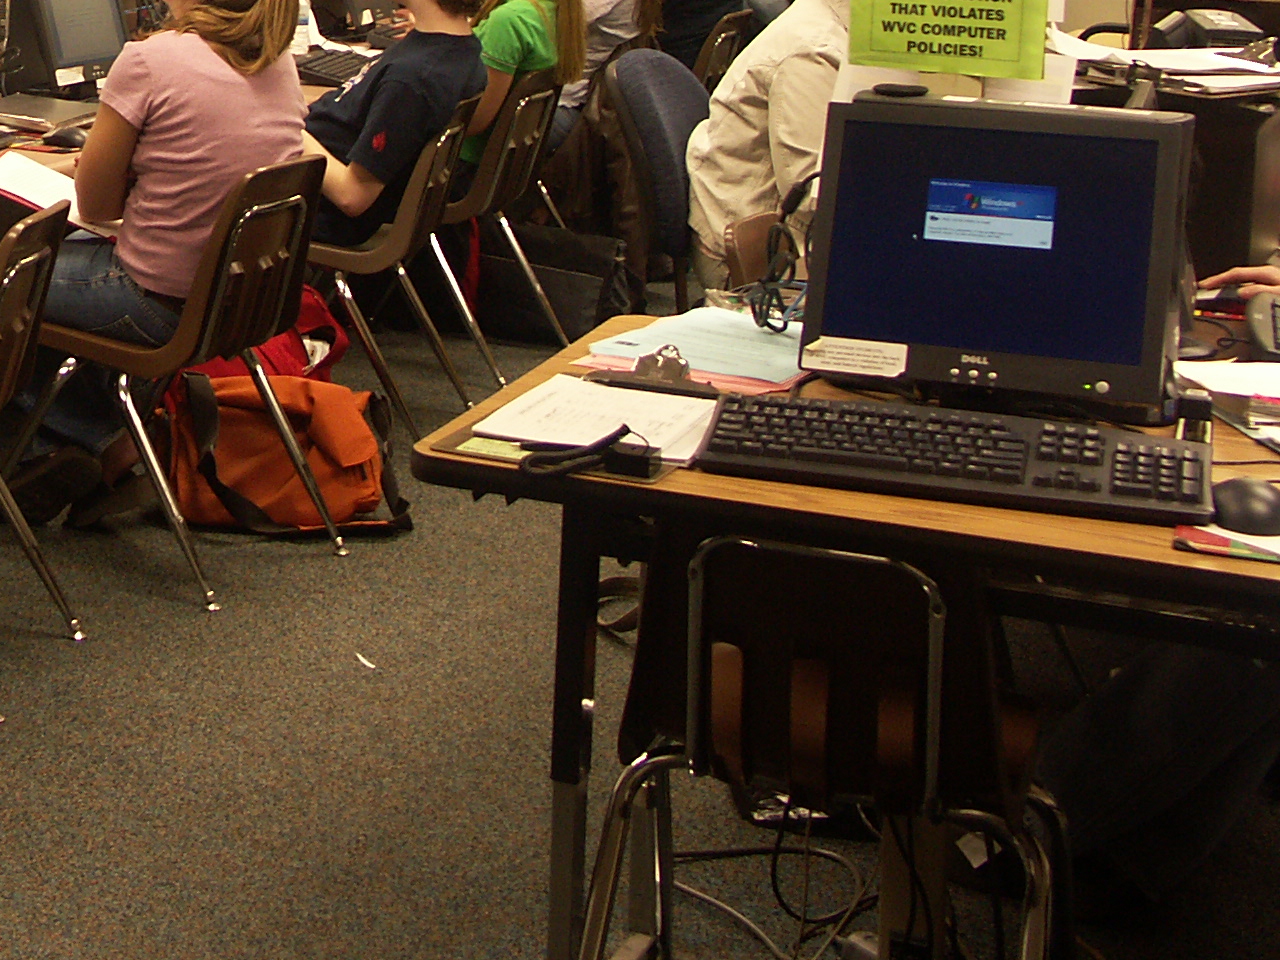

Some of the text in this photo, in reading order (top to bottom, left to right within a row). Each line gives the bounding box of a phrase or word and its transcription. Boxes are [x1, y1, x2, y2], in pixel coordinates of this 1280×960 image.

[890, 3, 1004, 22] THAT VIOLATES
[882, 20, 1007, 41] WVC COMPUTER
[906, 40, 983, 58] POLICIES!
[961, 354, 989, 365] DELL
